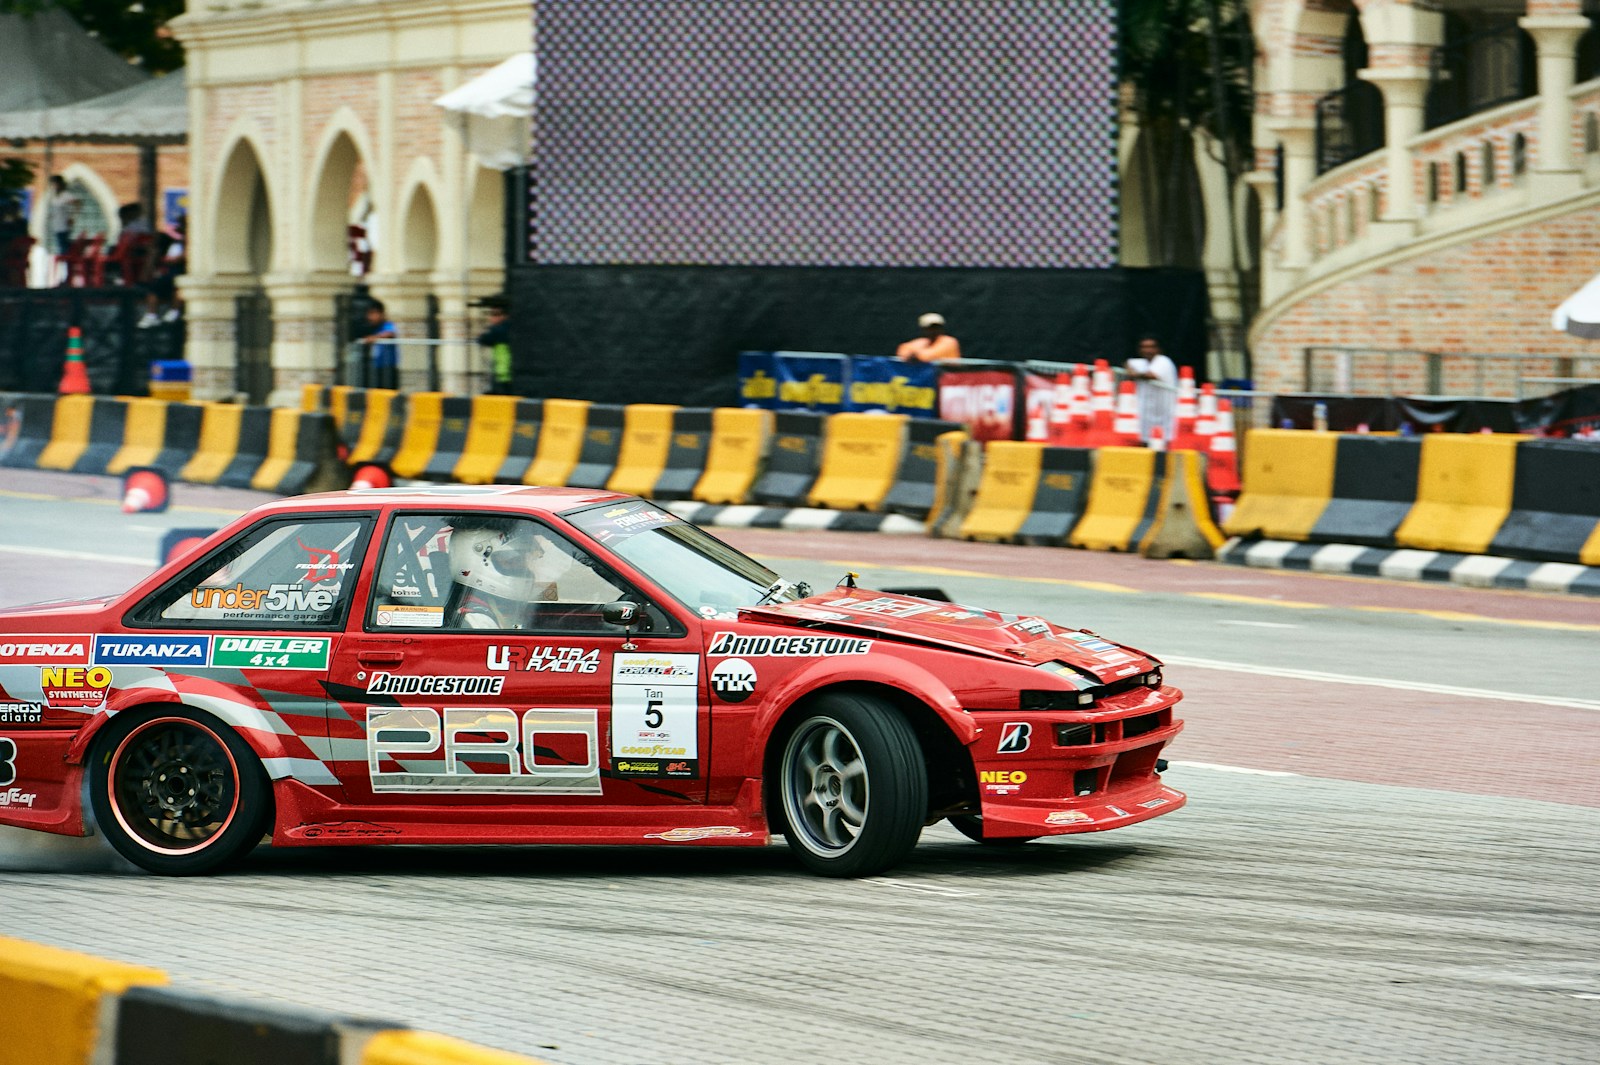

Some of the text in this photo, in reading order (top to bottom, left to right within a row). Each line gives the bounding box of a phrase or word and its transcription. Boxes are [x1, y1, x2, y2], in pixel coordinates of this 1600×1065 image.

[0, 643, 85, 656] OTENZA
[100, 643, 202, 657] TURANZA
[219, 638, 324, 653] DUELER
[708, 632, 873, 656] BRIDGESTONE
[250, 653, 289, 666] 4x4
[531, 646, 600, 660] ULTRA
[526, 659, 599, 673] RACING
[42, 667, 112, 688] NEO
[368, 673, 503, 694] BRIDGESTONE
[714, 673, 755, 692] TLK
[49, 690, 103, 698] SYNTHETICS
[644, 688, 663, 698] Tan
[644, 700, 663, 729] 5
[366, 707, 600, 778] PRO
[980, 770, 1027, 784] NEO
